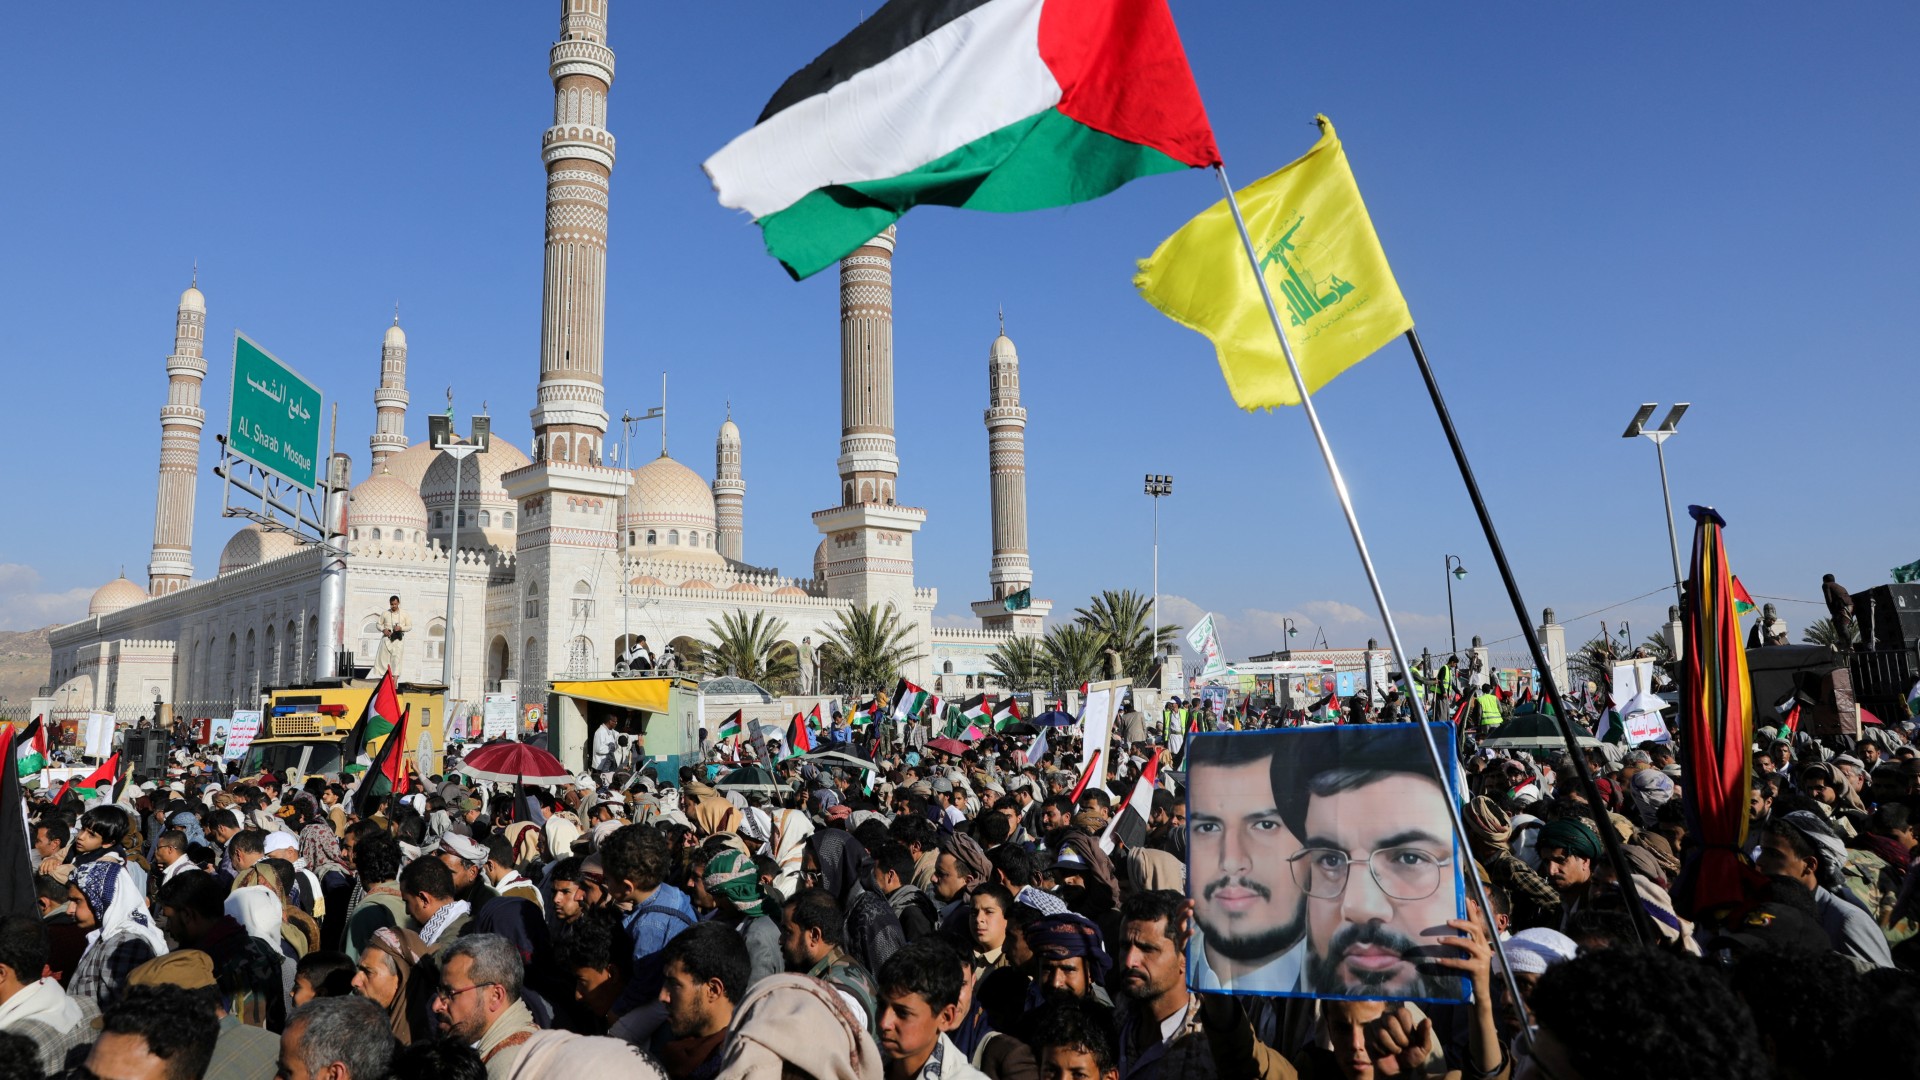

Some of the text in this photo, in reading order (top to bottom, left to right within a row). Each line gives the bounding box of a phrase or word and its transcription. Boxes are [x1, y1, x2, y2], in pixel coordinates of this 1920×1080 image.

[246, 371, 311, 425] جامع الشعب
[283, 441, 311, 471] Mosque
